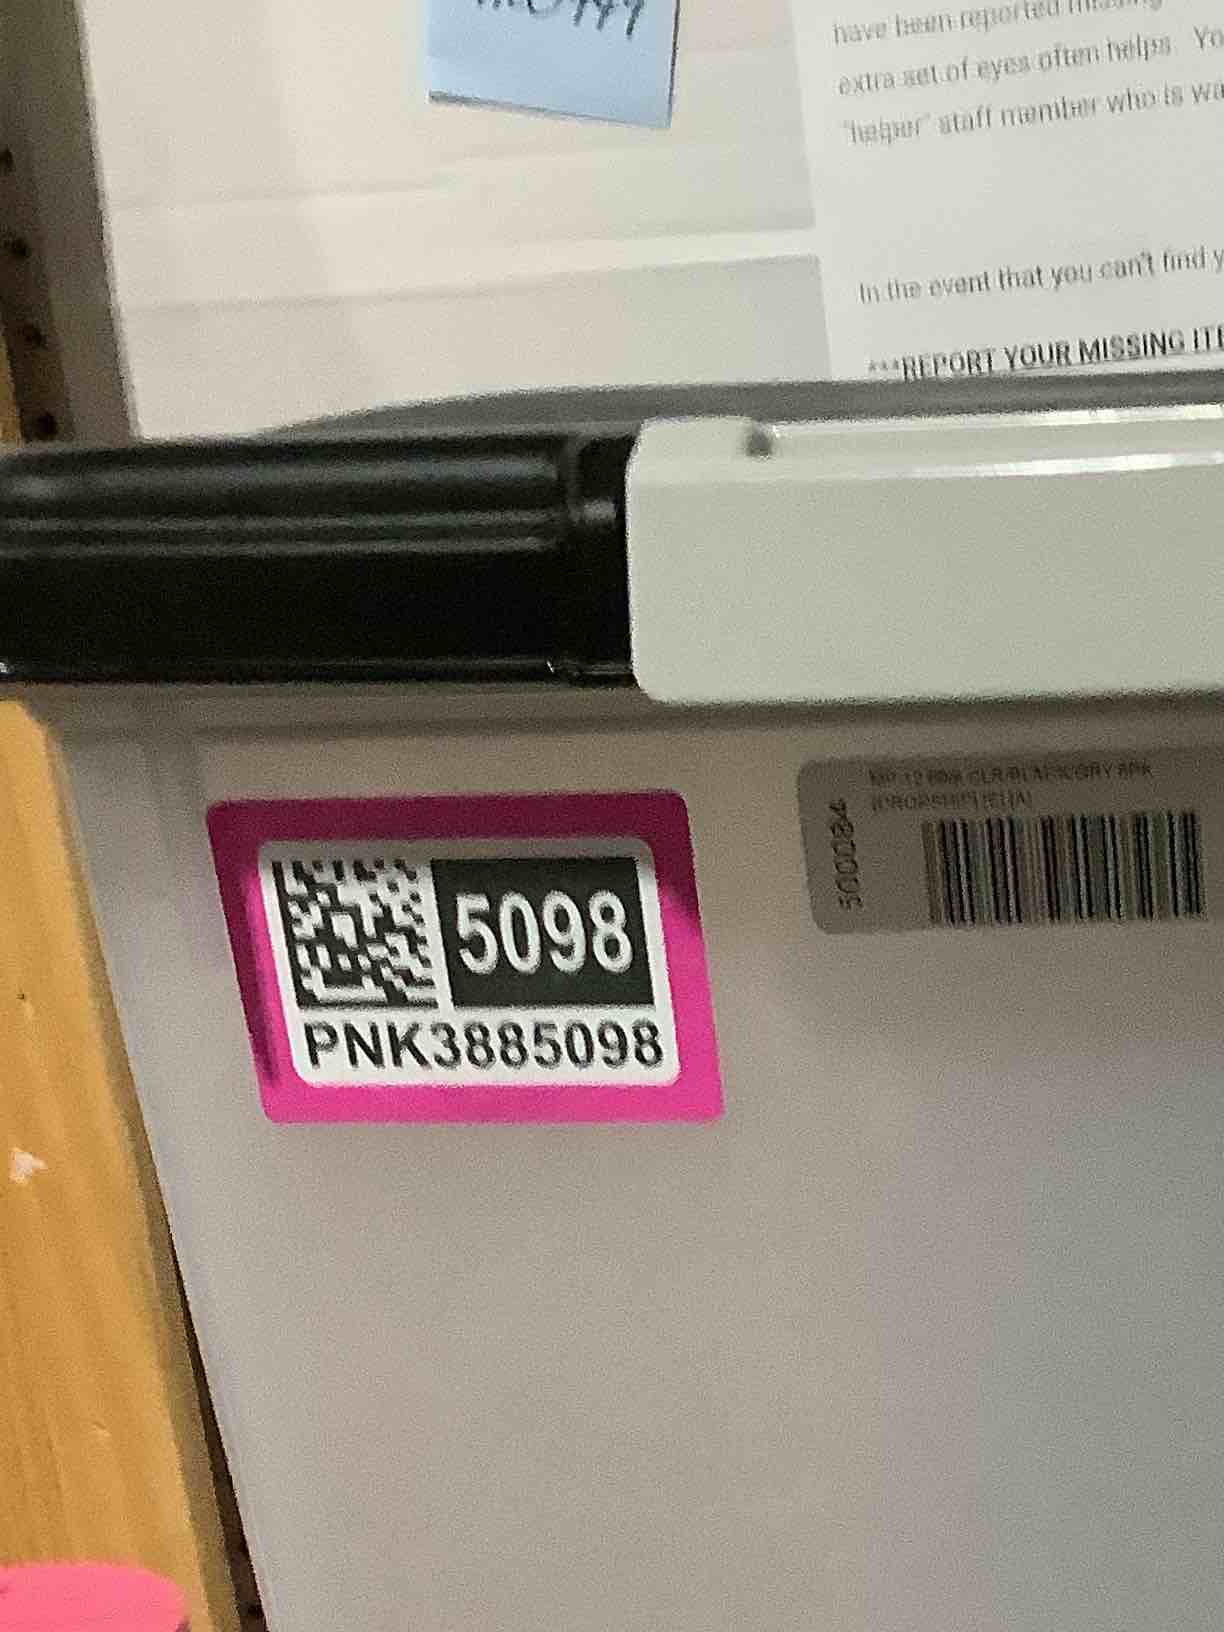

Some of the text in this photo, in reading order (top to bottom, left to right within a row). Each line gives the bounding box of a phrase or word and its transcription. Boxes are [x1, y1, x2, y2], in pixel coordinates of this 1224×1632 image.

[833, 19, 886, 45] have
[895, 11, 952, 37] been
[959, 0, 1060, 33] reported
[838, 70, 895, 96] extra
[903, 63, 938, 88] set
[945, 55, 970, 84] of
[977, 53, 1029, 84] eyes
[1038, 43, 1100, 72] often
[937, 104, 992, 135] staff
[1001, 95, 1096, 127] member
[1106, 86, 1155, 114] who
[1164, 80, 1184, 107] is
[859, 281, 879, 303] In
[886, 277, 922, 299] the
[928, 271, 992, 297] event
[999, 264, 1044, 290] that
[1051, 262, 1093, 291] you
[1099, 249, 1155, 279] can't
[1163, 243, 1206, 273] find
[1003, 339, 1072, 372] YOUR
[1078, 327, 1187, 363] MISSING
[455, 889, 635, 976] 5098
[302, 1019, 666, 1072] PNK3885098
